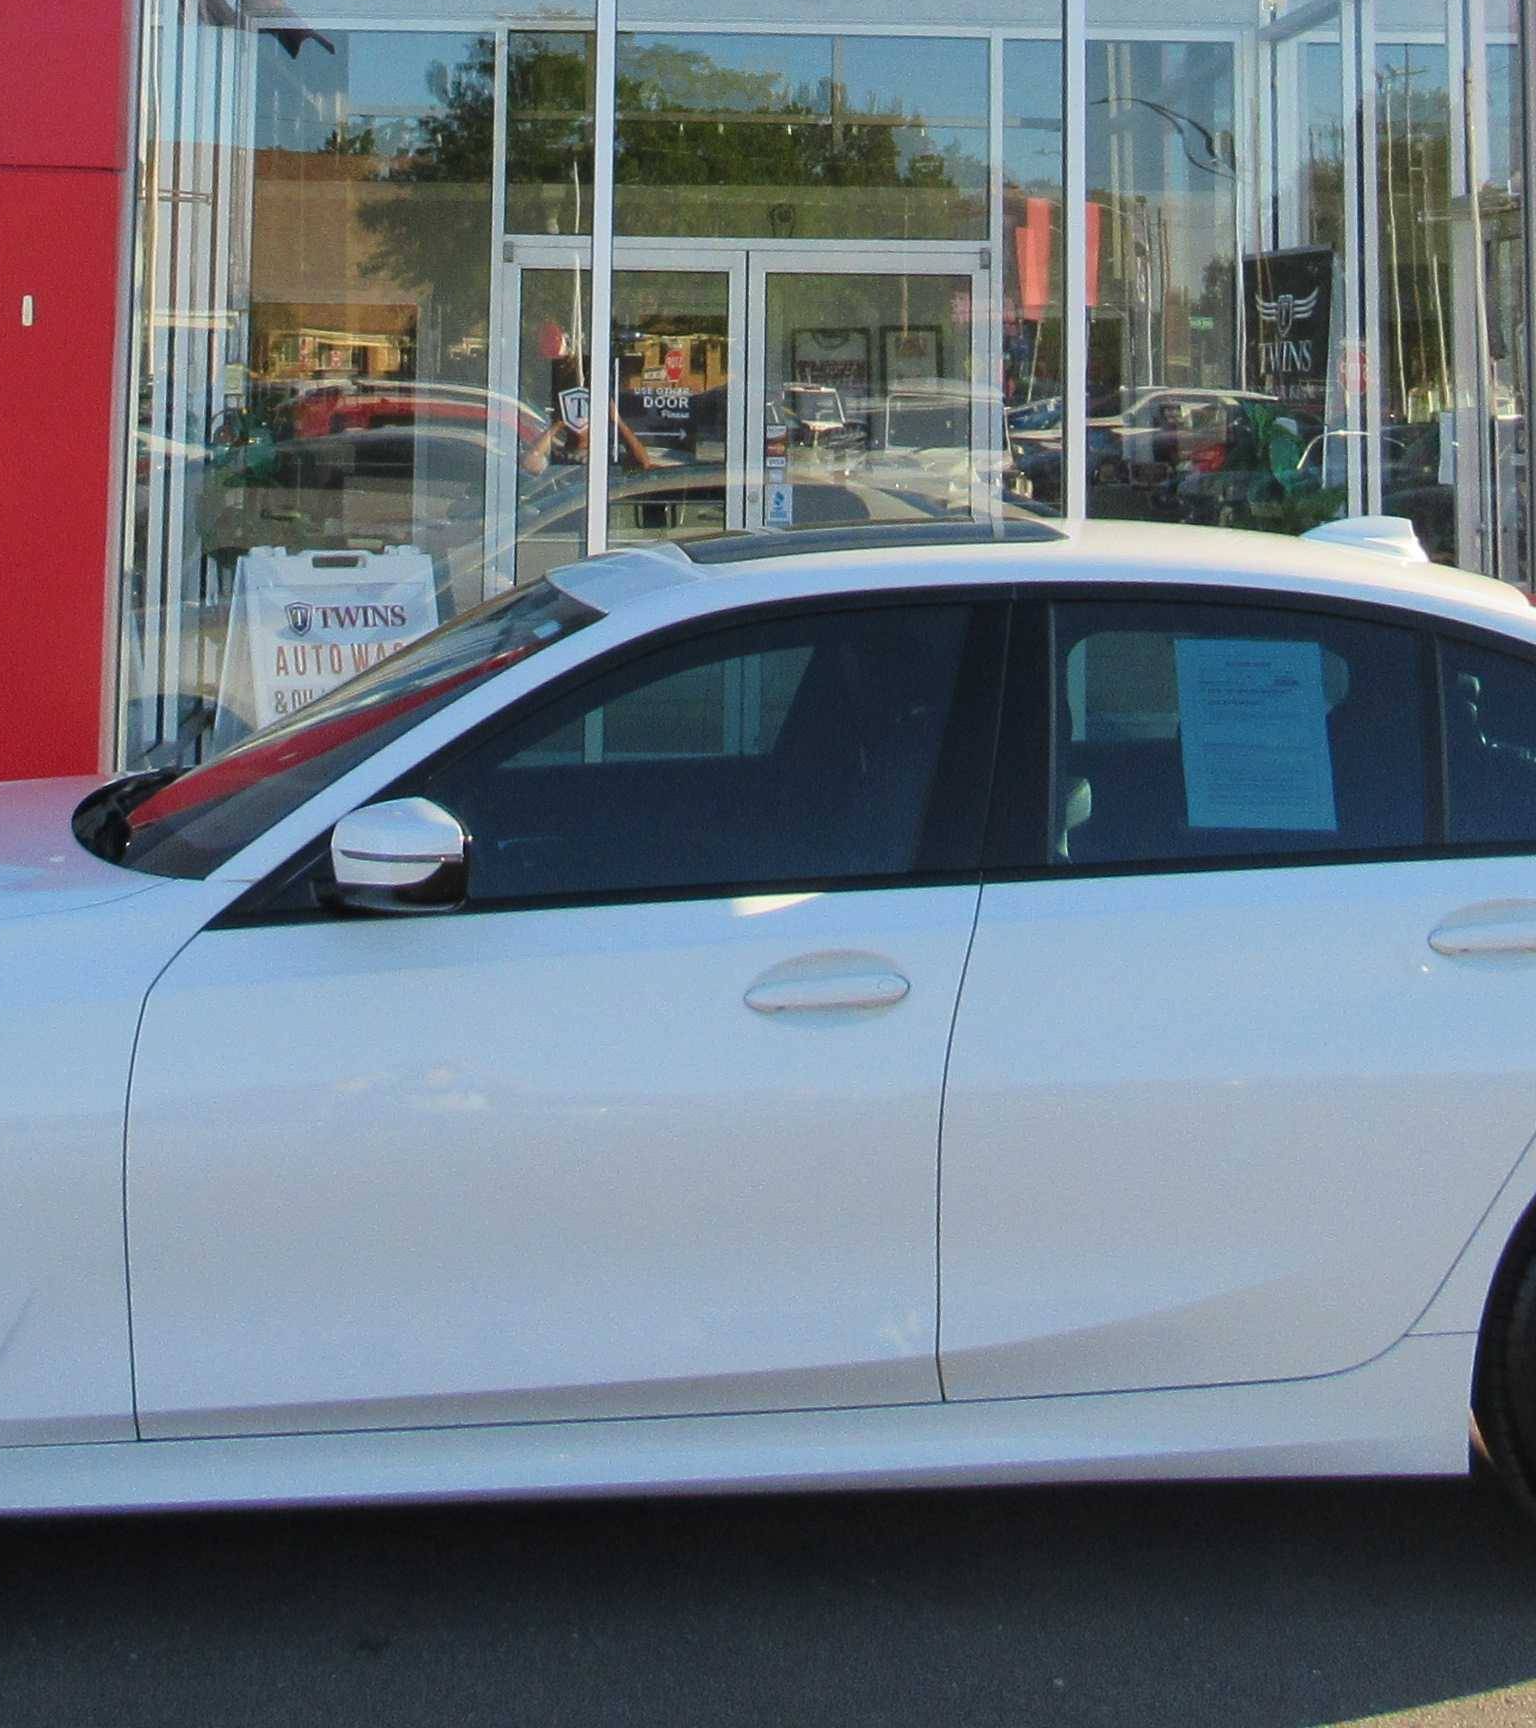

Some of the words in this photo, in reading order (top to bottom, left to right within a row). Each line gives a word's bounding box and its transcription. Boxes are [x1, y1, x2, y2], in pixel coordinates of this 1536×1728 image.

[1258, 339, 1313, 374] TWINS
[642, 395, 690, 409] DOOR
[315, 604, 407, 629] TWINS
[275, 643, 344, 676] AUTO
[274, 689, 289, 714] &
